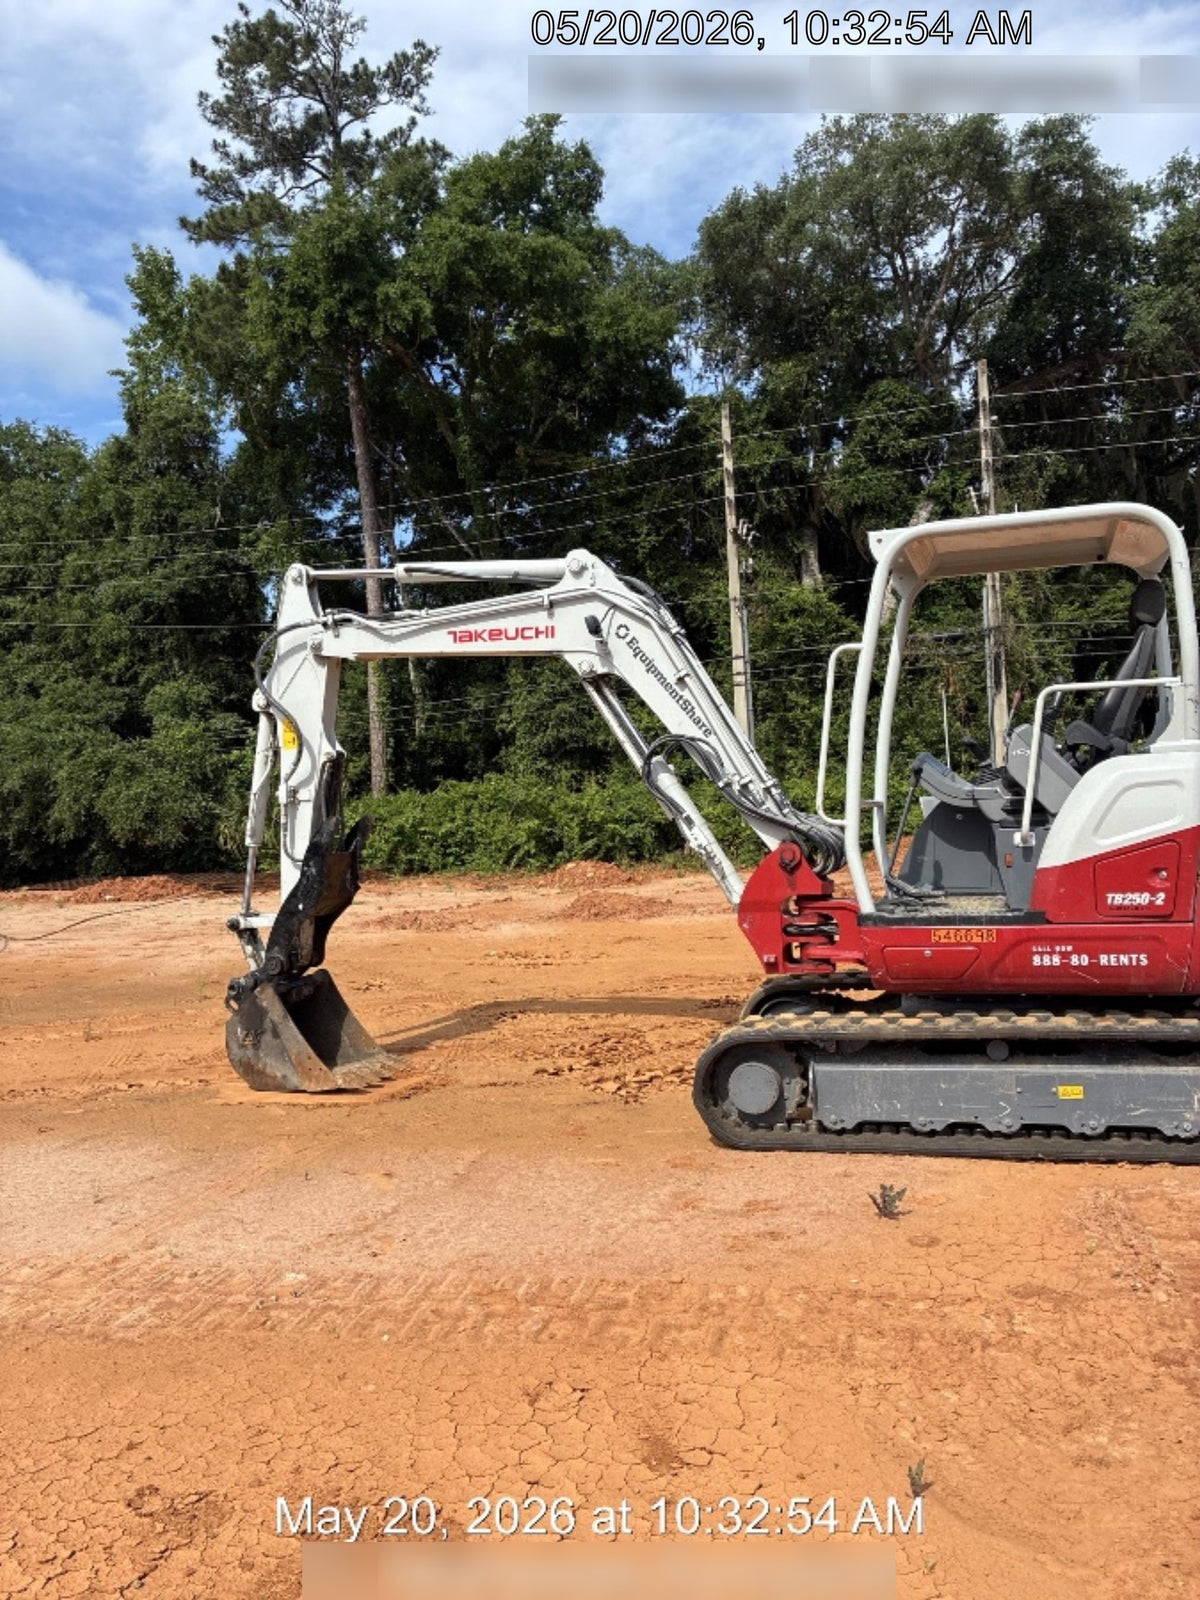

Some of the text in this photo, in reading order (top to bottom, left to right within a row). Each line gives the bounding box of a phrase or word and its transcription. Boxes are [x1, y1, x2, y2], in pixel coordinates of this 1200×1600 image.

[626, 636, 712, 738] EquipmentShare
[1105, 892, 1166, 906] TB250-2
[1032, 954, 1148, 966] 888-80-RENTS
